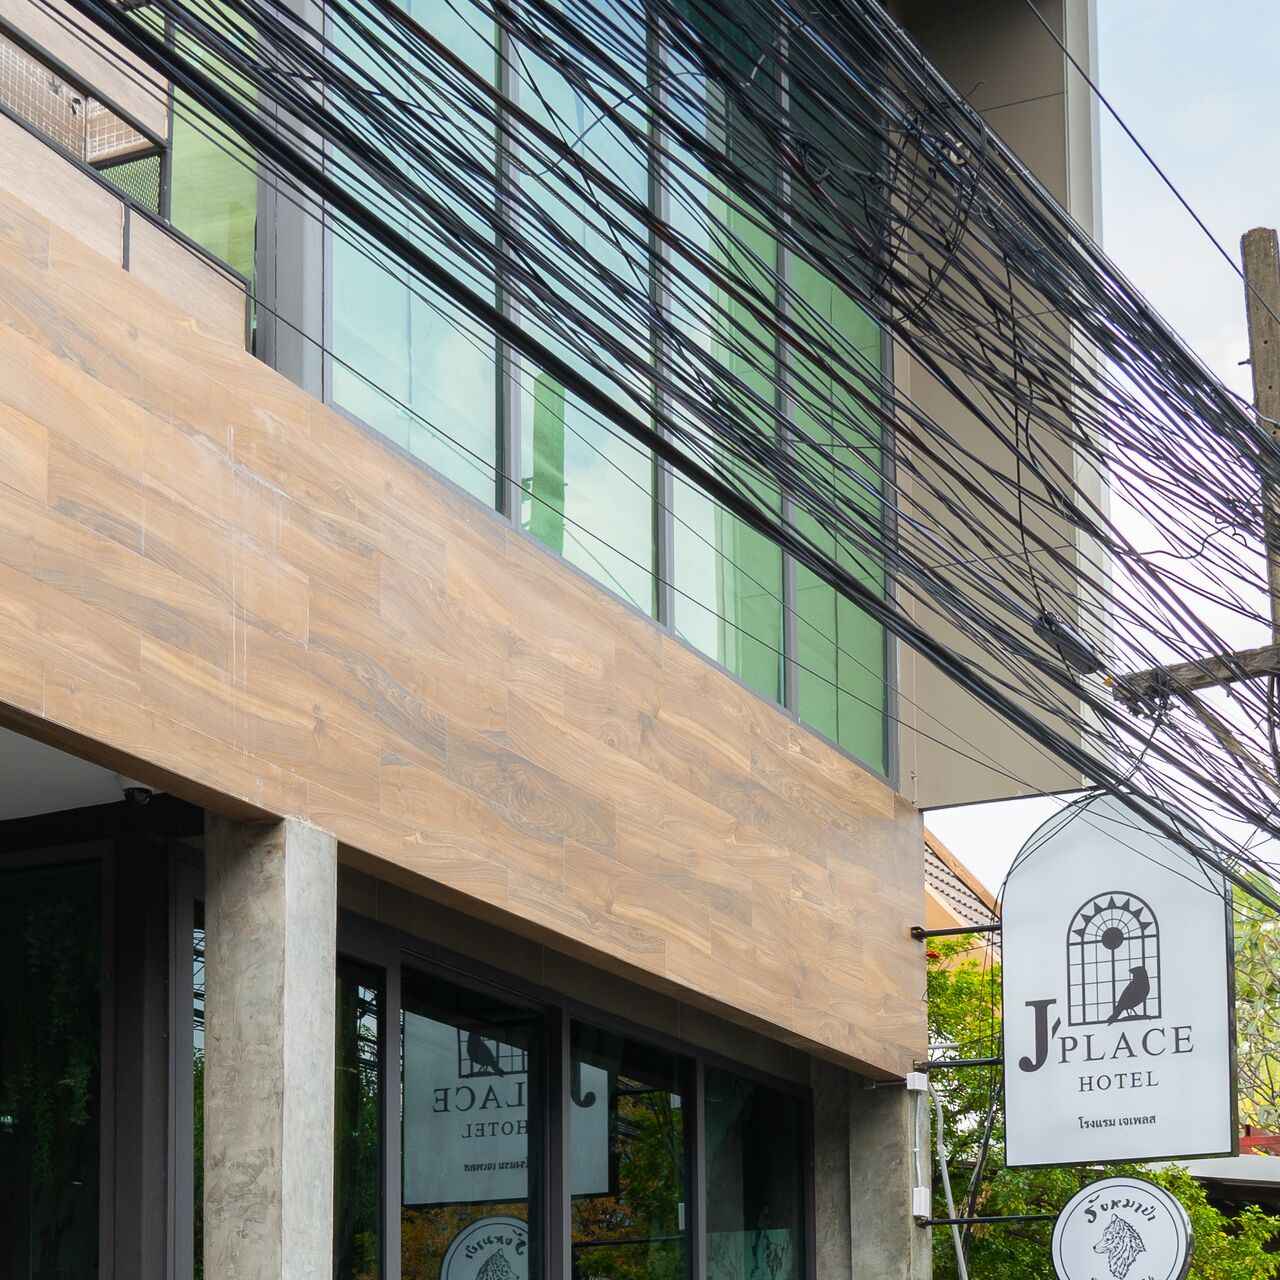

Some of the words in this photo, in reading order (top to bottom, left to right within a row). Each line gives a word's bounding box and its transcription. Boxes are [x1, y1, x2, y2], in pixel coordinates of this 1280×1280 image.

[1078, 1070, 1160, 1093] HOTEL
[1078, 1116, 1116, 1130] โรงแรม
[1118, 1114, 1156, 1127] เจเพลส
